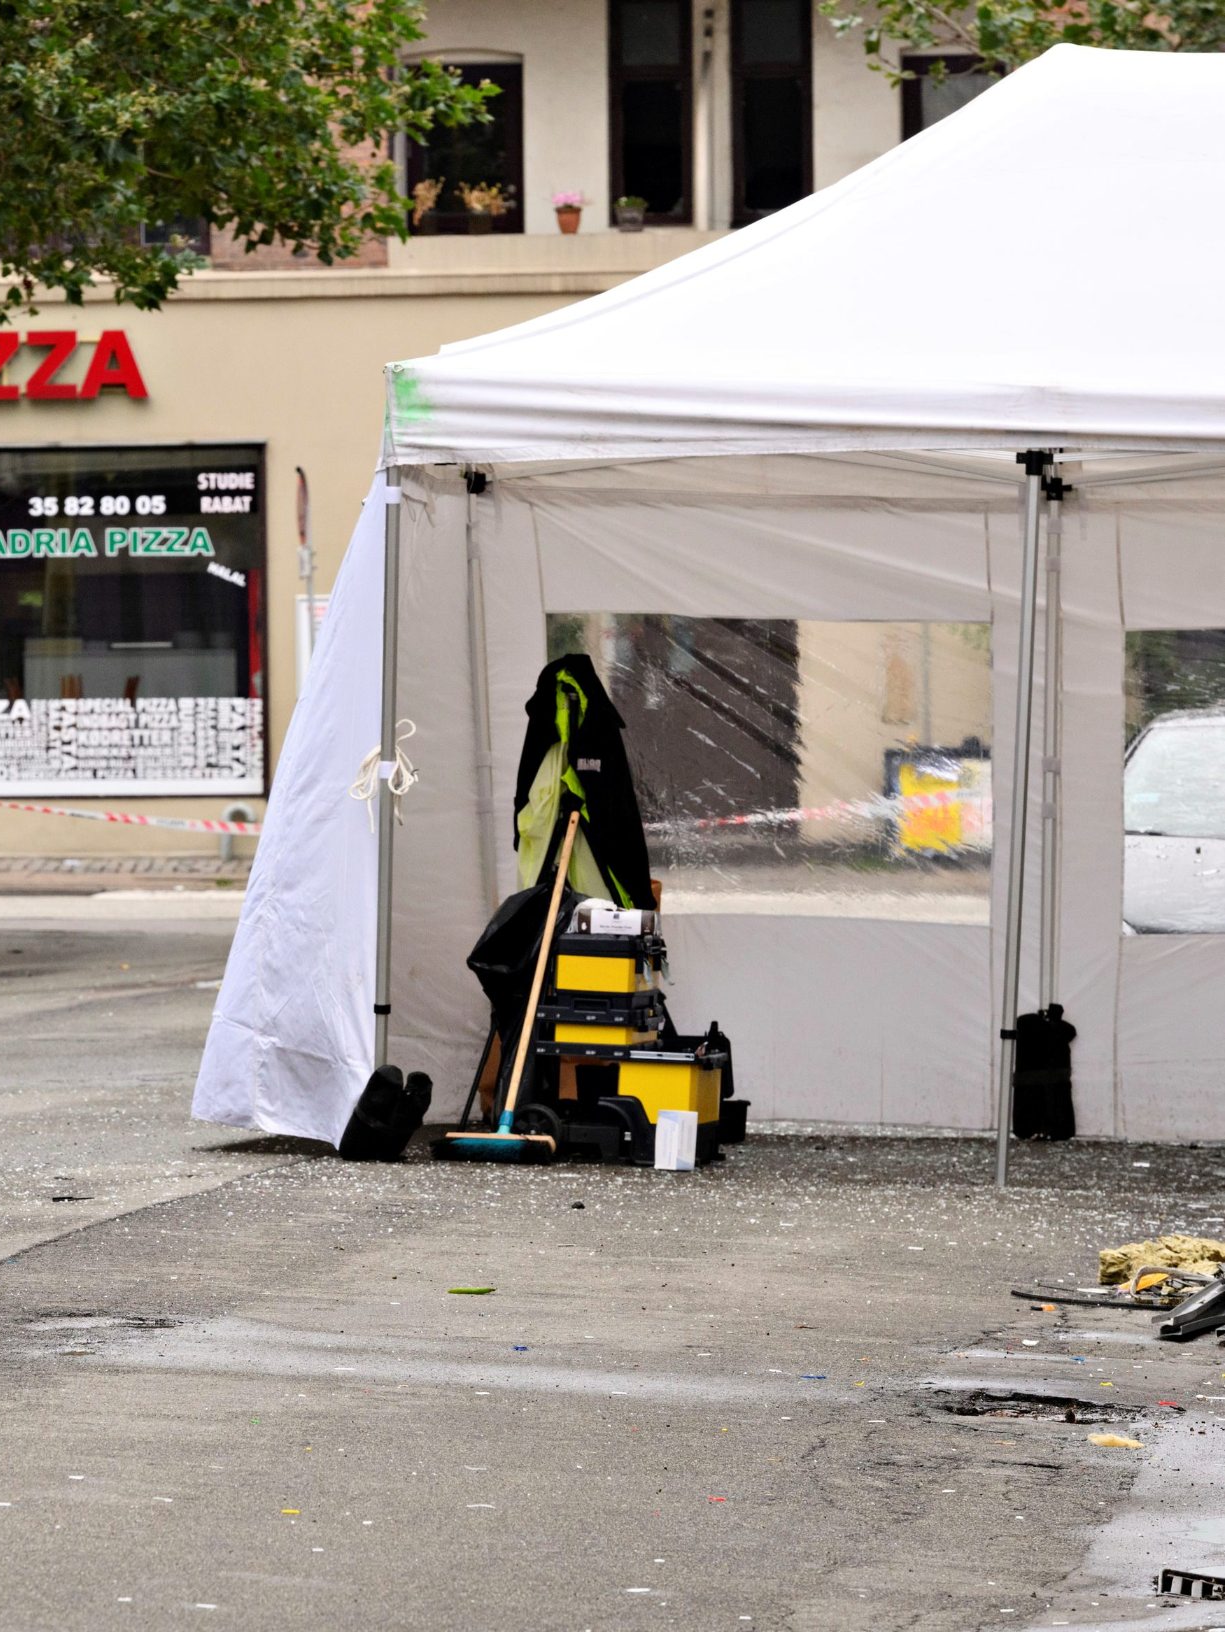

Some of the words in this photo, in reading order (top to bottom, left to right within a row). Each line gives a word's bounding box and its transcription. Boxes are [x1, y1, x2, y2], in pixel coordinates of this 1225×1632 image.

[197, 471, 256, 490] STUDIE
[28, 496, 59, 517] 35
[63, 495, 95, 516] 82
[99, 494, 131, 516] 80
[135, 494, 167, 515] 05
[200, 495, 253, 513] RABAT
[104, 526, 216, 558] PIZZA
[207, 561, 247, 588] HALAL
[137, 698, 177, 712] PIZZA
[140, 713, 179, 727] PIZZA
[60, 699, 77, 771] PASTA
